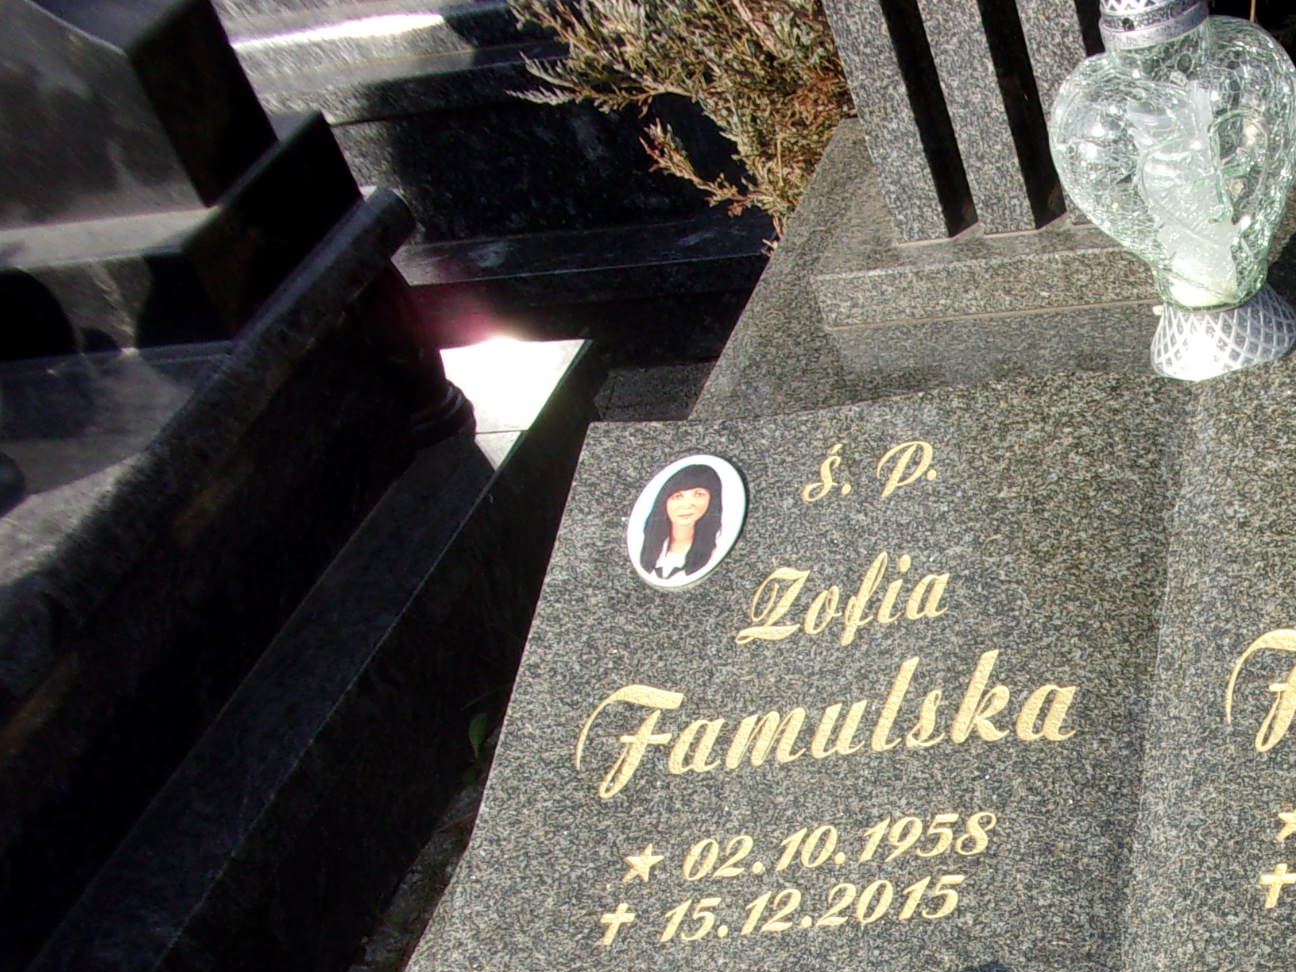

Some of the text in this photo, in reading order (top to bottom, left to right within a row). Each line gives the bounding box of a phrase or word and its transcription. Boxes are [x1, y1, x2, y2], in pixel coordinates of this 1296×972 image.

[735, 551, 951, 647] Zofia
[574, 648, 1079, 801] Famulska
[681, 811, 998, 882] 02.10.1958
[659, 874, 966, 943] 15.12.2015
